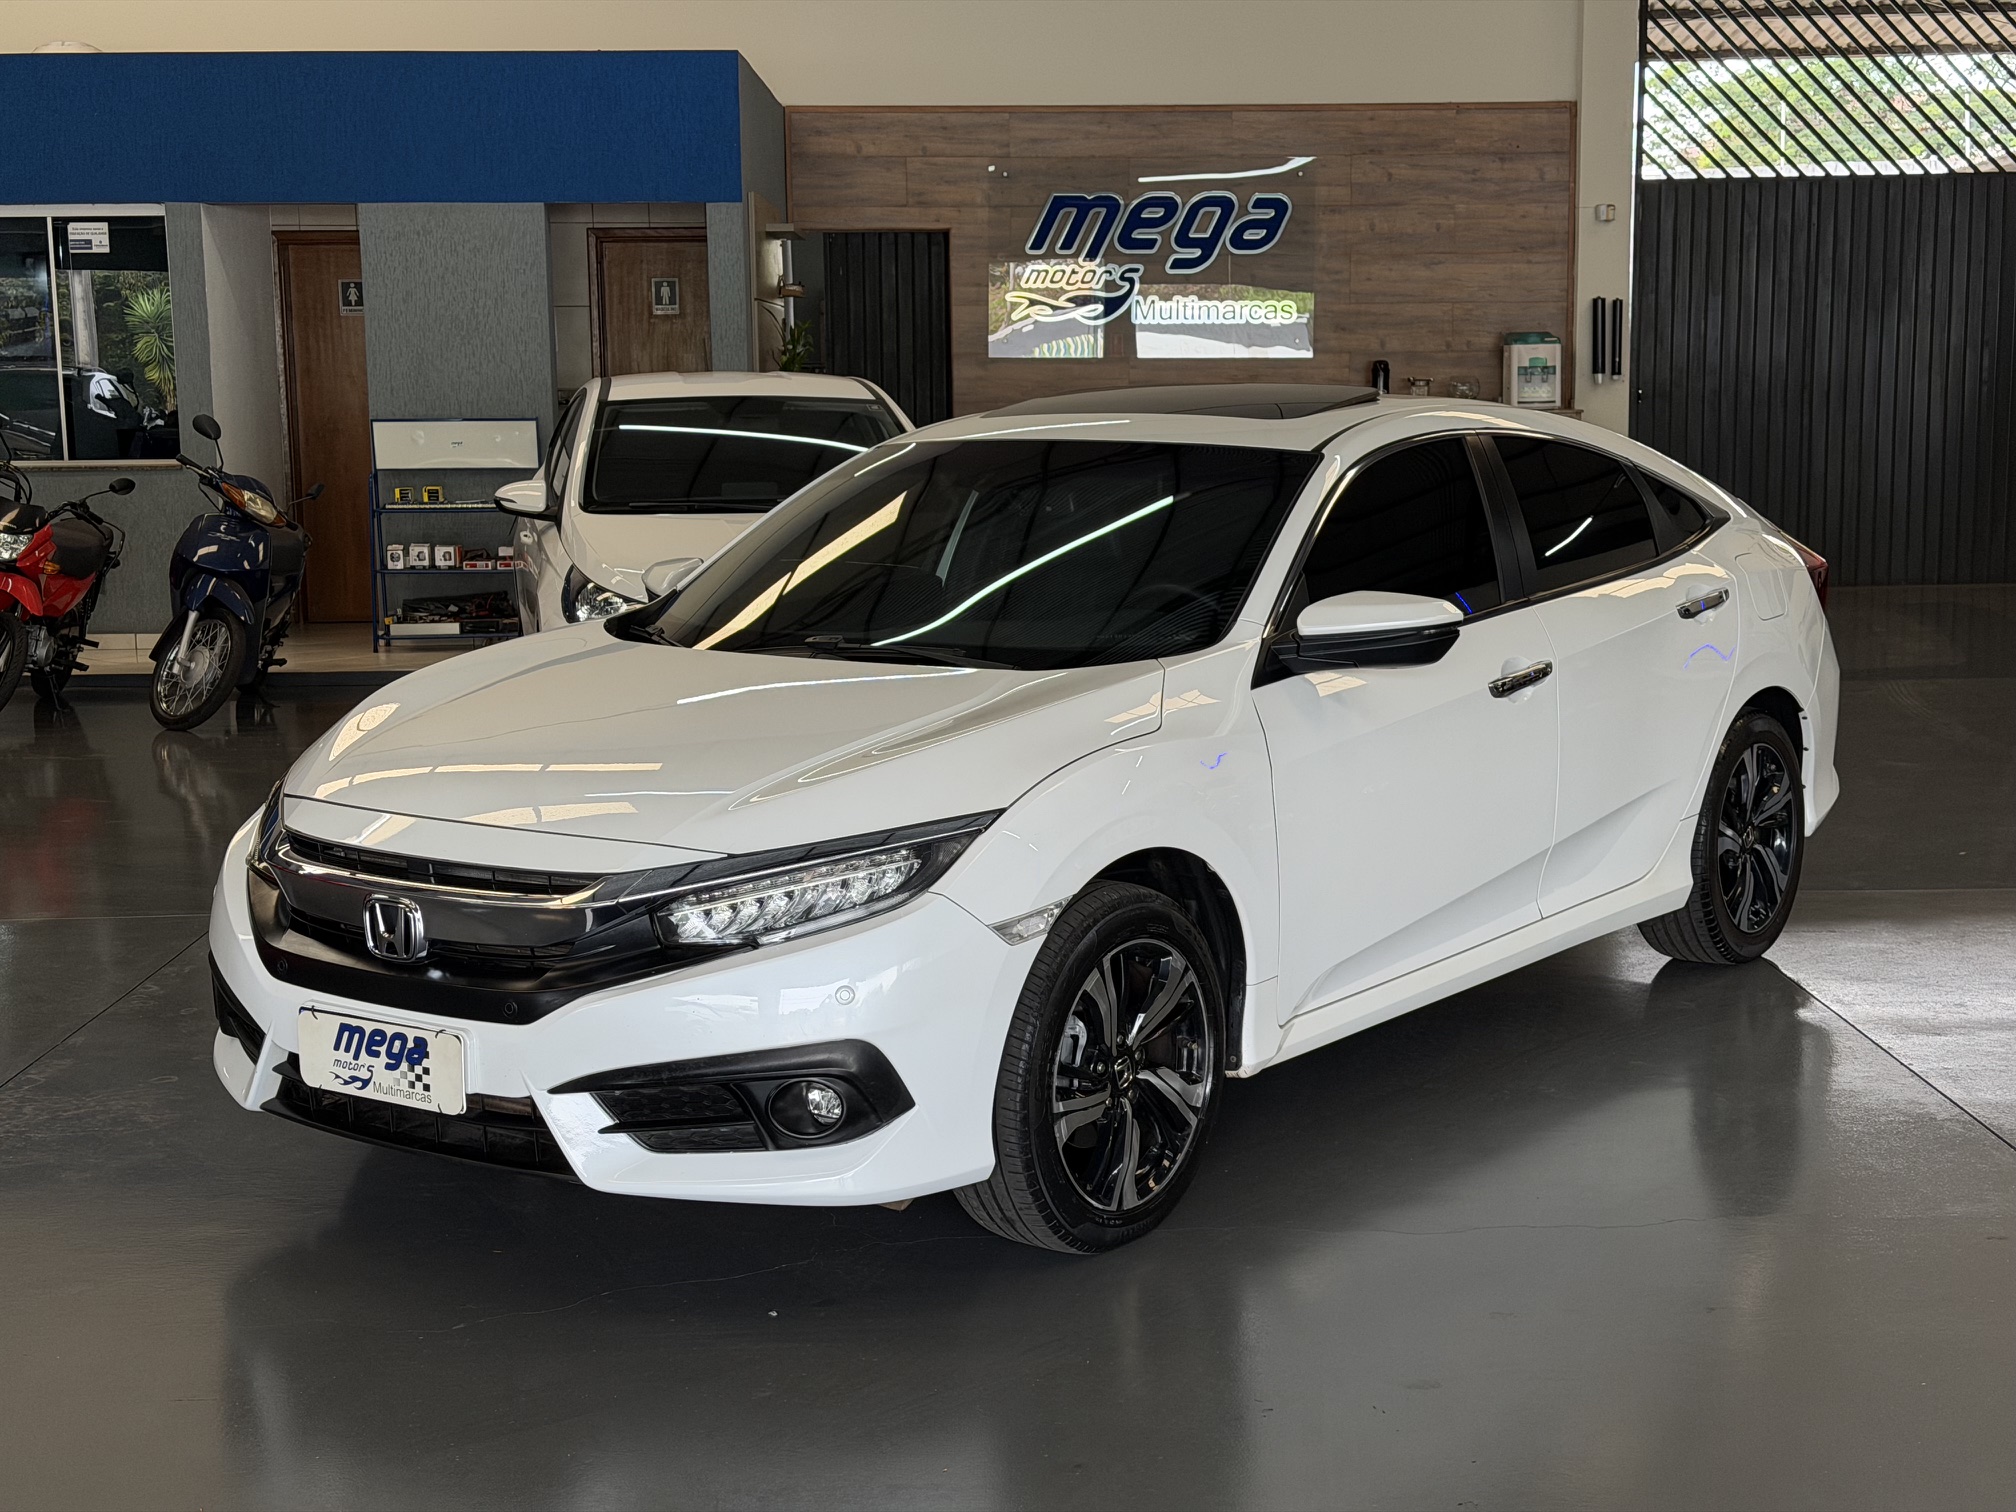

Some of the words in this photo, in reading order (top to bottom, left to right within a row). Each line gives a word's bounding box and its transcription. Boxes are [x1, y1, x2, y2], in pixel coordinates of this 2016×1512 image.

[1026, 191, 1292, 274] mega
[1133, 297, 1296, 323] Multimarcas
[333, 1022, 429, 1072] mega
[372, 1081, 432, 1104] Multimarcas
